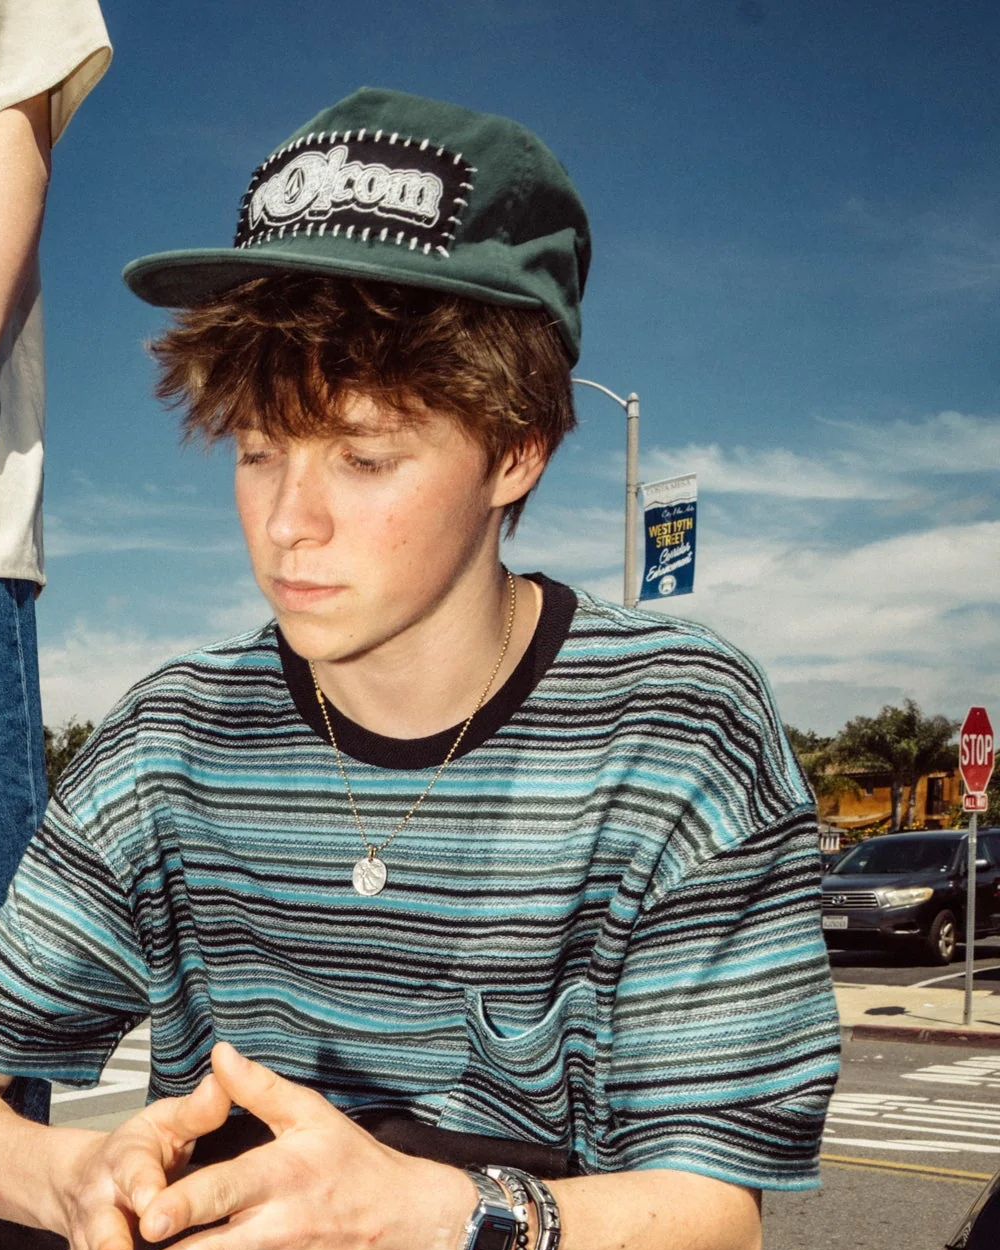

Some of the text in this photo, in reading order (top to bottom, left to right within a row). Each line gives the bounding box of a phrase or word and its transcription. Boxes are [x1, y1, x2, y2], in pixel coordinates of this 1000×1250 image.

[648, 517, 693, 538] WEST 19TH
[656, 531, 685, 548] STREET
[961, 733, 993, 766] STOP
